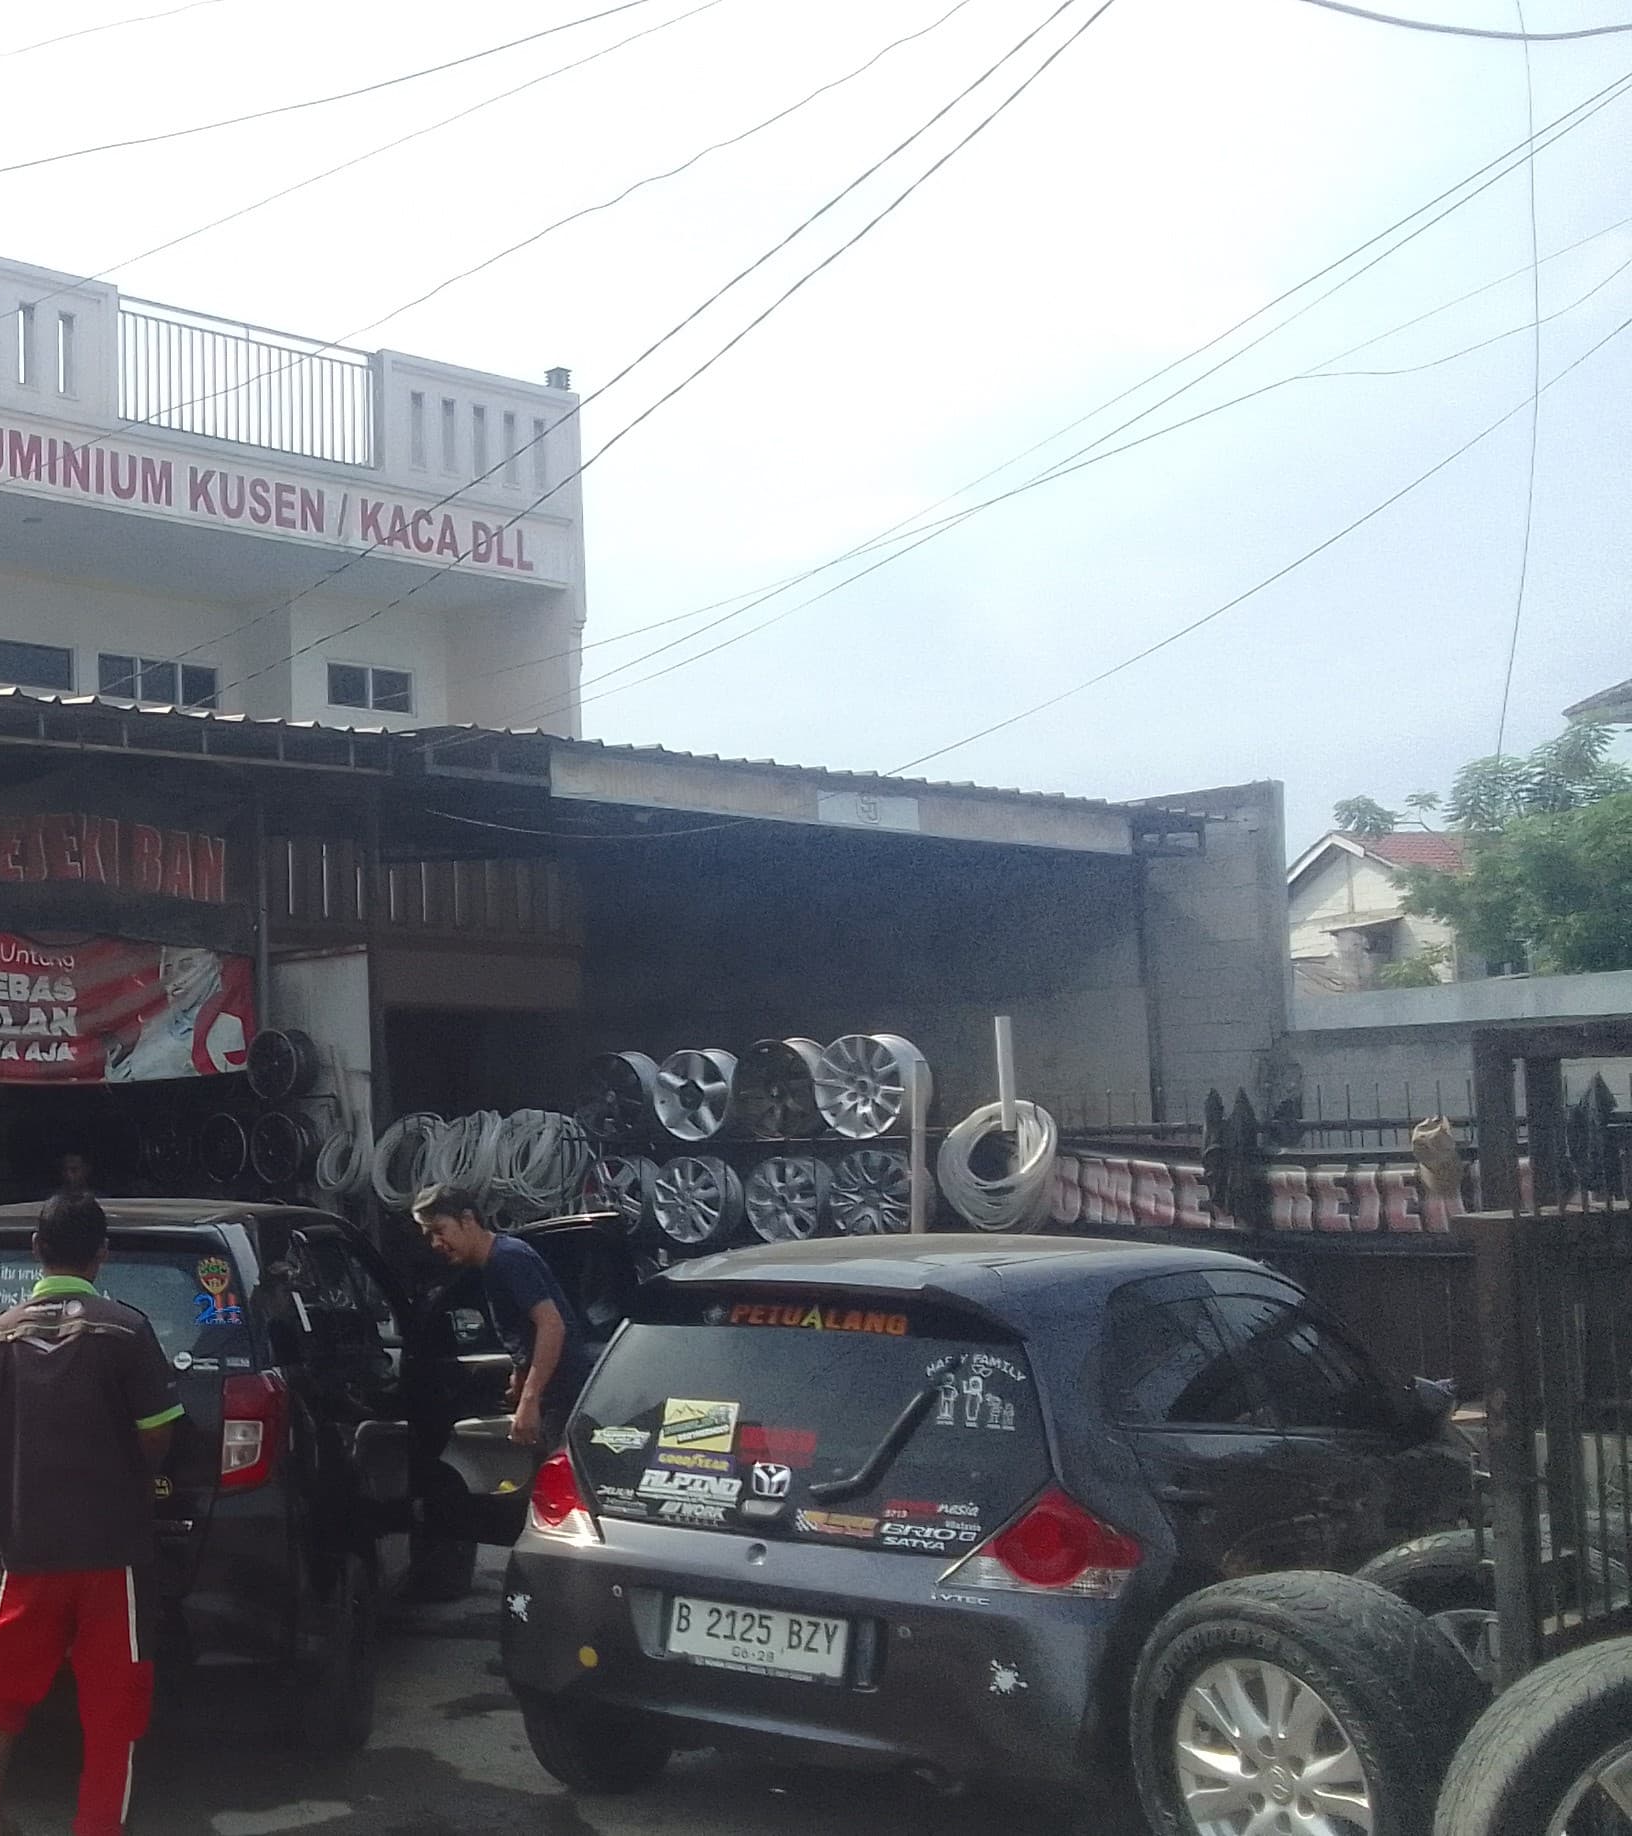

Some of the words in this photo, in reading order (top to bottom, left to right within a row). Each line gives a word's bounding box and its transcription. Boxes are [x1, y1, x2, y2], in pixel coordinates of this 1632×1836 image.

[188, 466, 324, 534] KUSEN
[359, 500, 461, 560] KACA
[471, 520, 534, 571] DLL
[132, 823, 225, 903] BAN
[883, 1536, 946, 1551] SATYA
[676, 1602, 692, 1633] B
[705, 1607, 775, 1645] 2125
[786, 1618, 839, 1656] BZY
